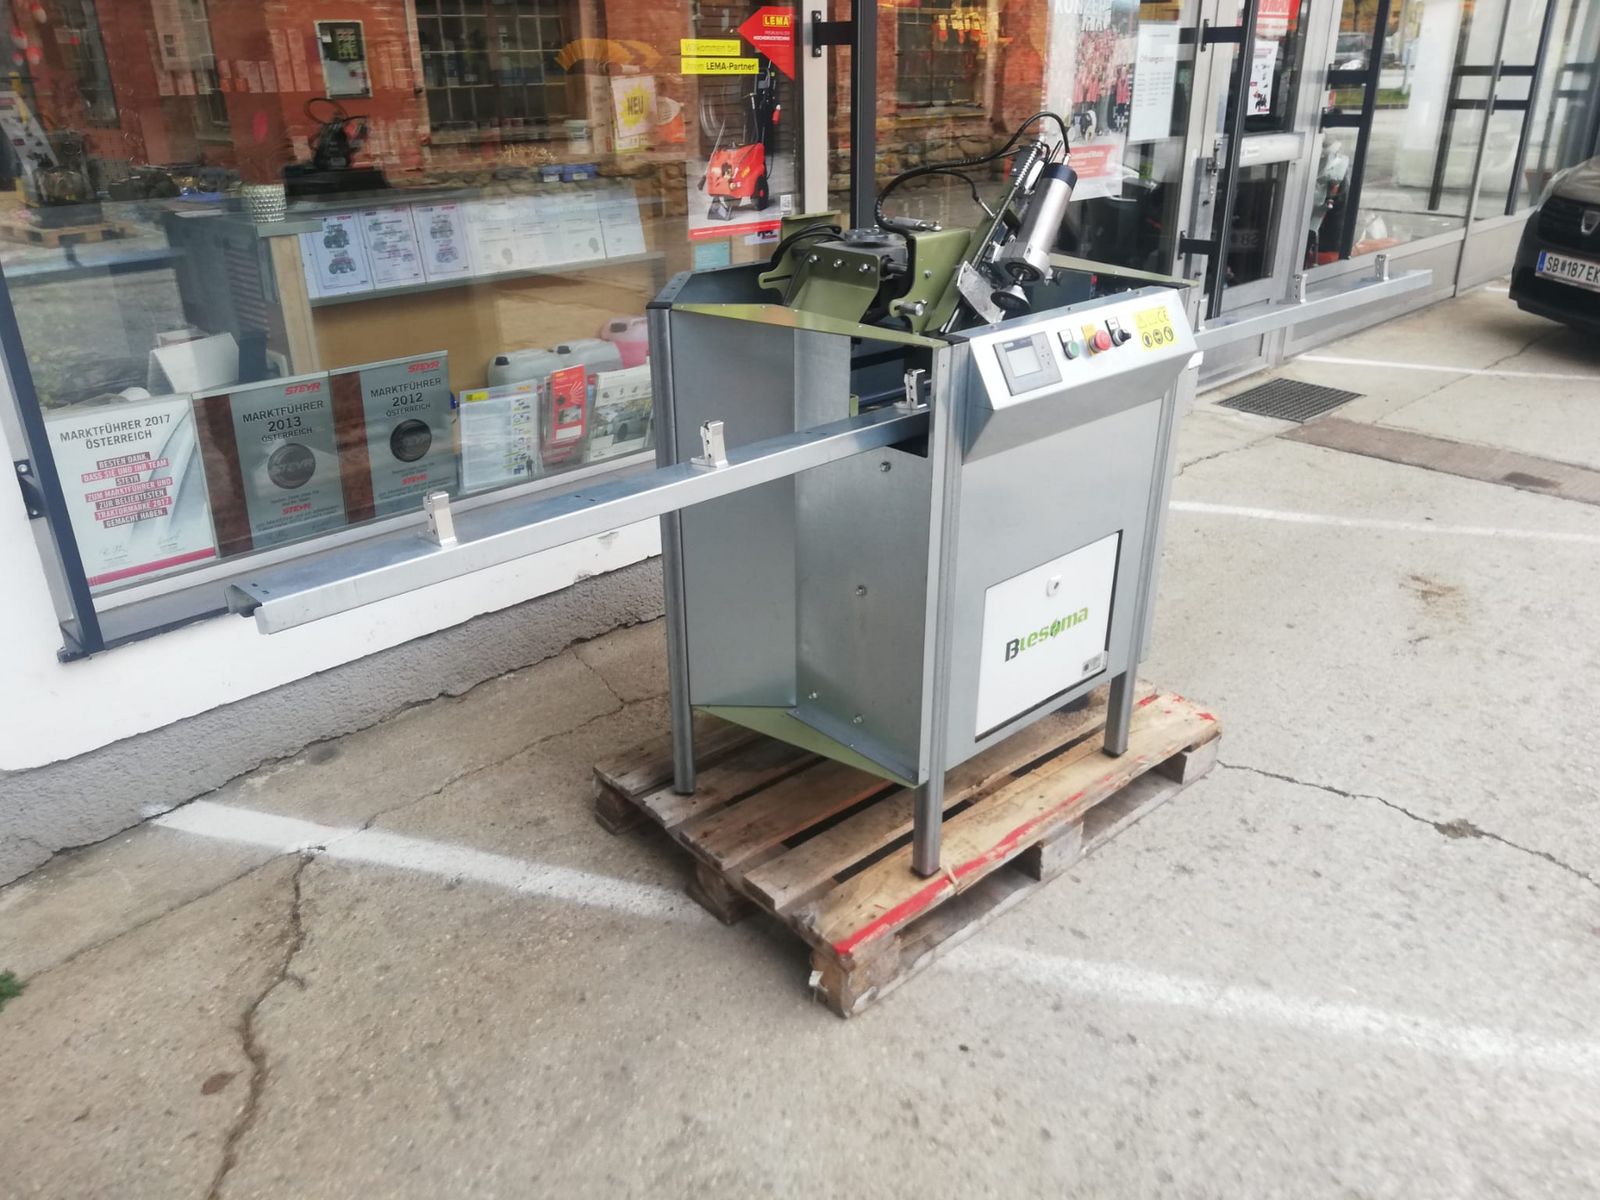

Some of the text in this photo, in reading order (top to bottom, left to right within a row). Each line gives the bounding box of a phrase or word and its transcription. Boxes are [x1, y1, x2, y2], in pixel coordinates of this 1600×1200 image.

[764, 15, 790, 26] LEMA
[706, 62, 755, 71] LEMA-Partner
[627, 95, 645, 116] NEU
[1546, 256, 1560, 272] SB
[1567, 261, 1585, 278] 187
[284, 381, 321, 396] STEYR
[392, 392, 423, 407] 2012
[60, 414, 170, 442] MARKTFÜHRER 2017
[267, 416, 302, 432] 2013
[86, 430, 153, 449] ÖSTERREICH
[99, 457, 126, 469] BESTEN
[83, 472, 102, 482] DASS
[117, 466, 133, 475] UND
[148, 460, 168, 470] TEAM
[116, 475, 139, 485] STEYR
[157, 479, 172, 488] UND
[99, 500, 114, 510] ZUR
[106, 514, 138, 527] GEMACHT
